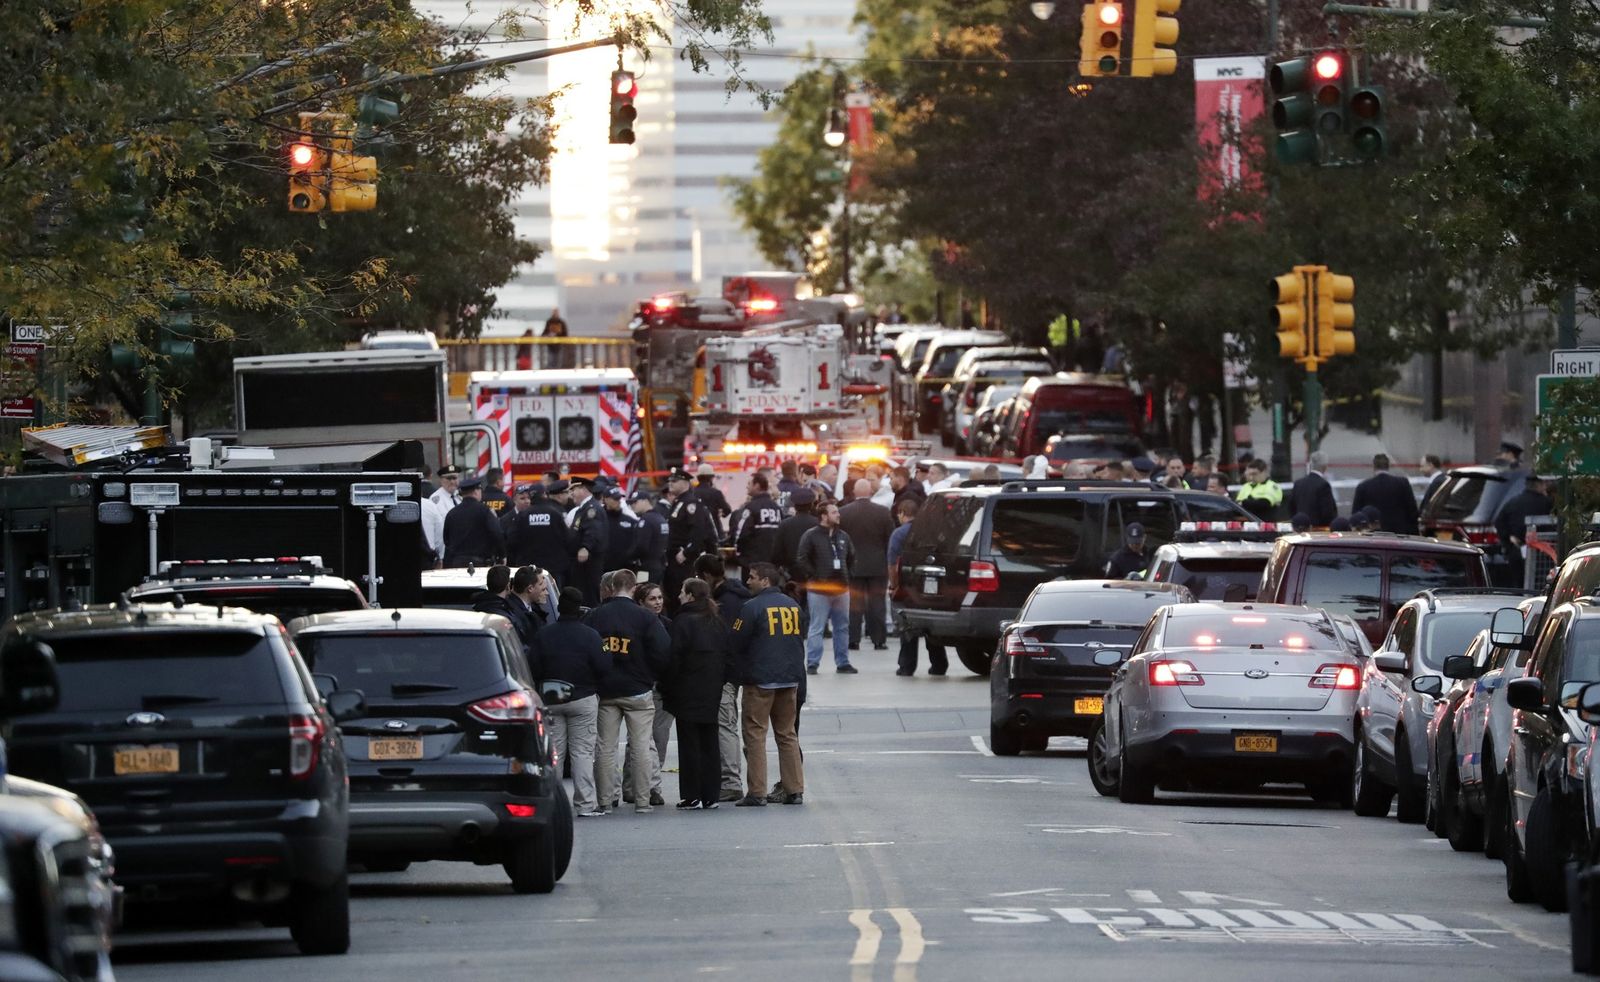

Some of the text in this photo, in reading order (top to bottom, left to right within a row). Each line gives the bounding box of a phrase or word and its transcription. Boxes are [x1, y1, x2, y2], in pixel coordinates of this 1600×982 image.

[1217, 67, 1243, 77] NYC
[19, 326, 43, 339] ONE
[1556, 361, 1593, 375] RIGHT
[712, 364, 724, 392] 1
[818, 362, 831, 390] 1
[519, 399, 590, 411] F.D. N.Y.
[529, 513, 551, 522] NYPD
[732, 618, 743, 631] BI
[767, 606, 801, 636] FBI
